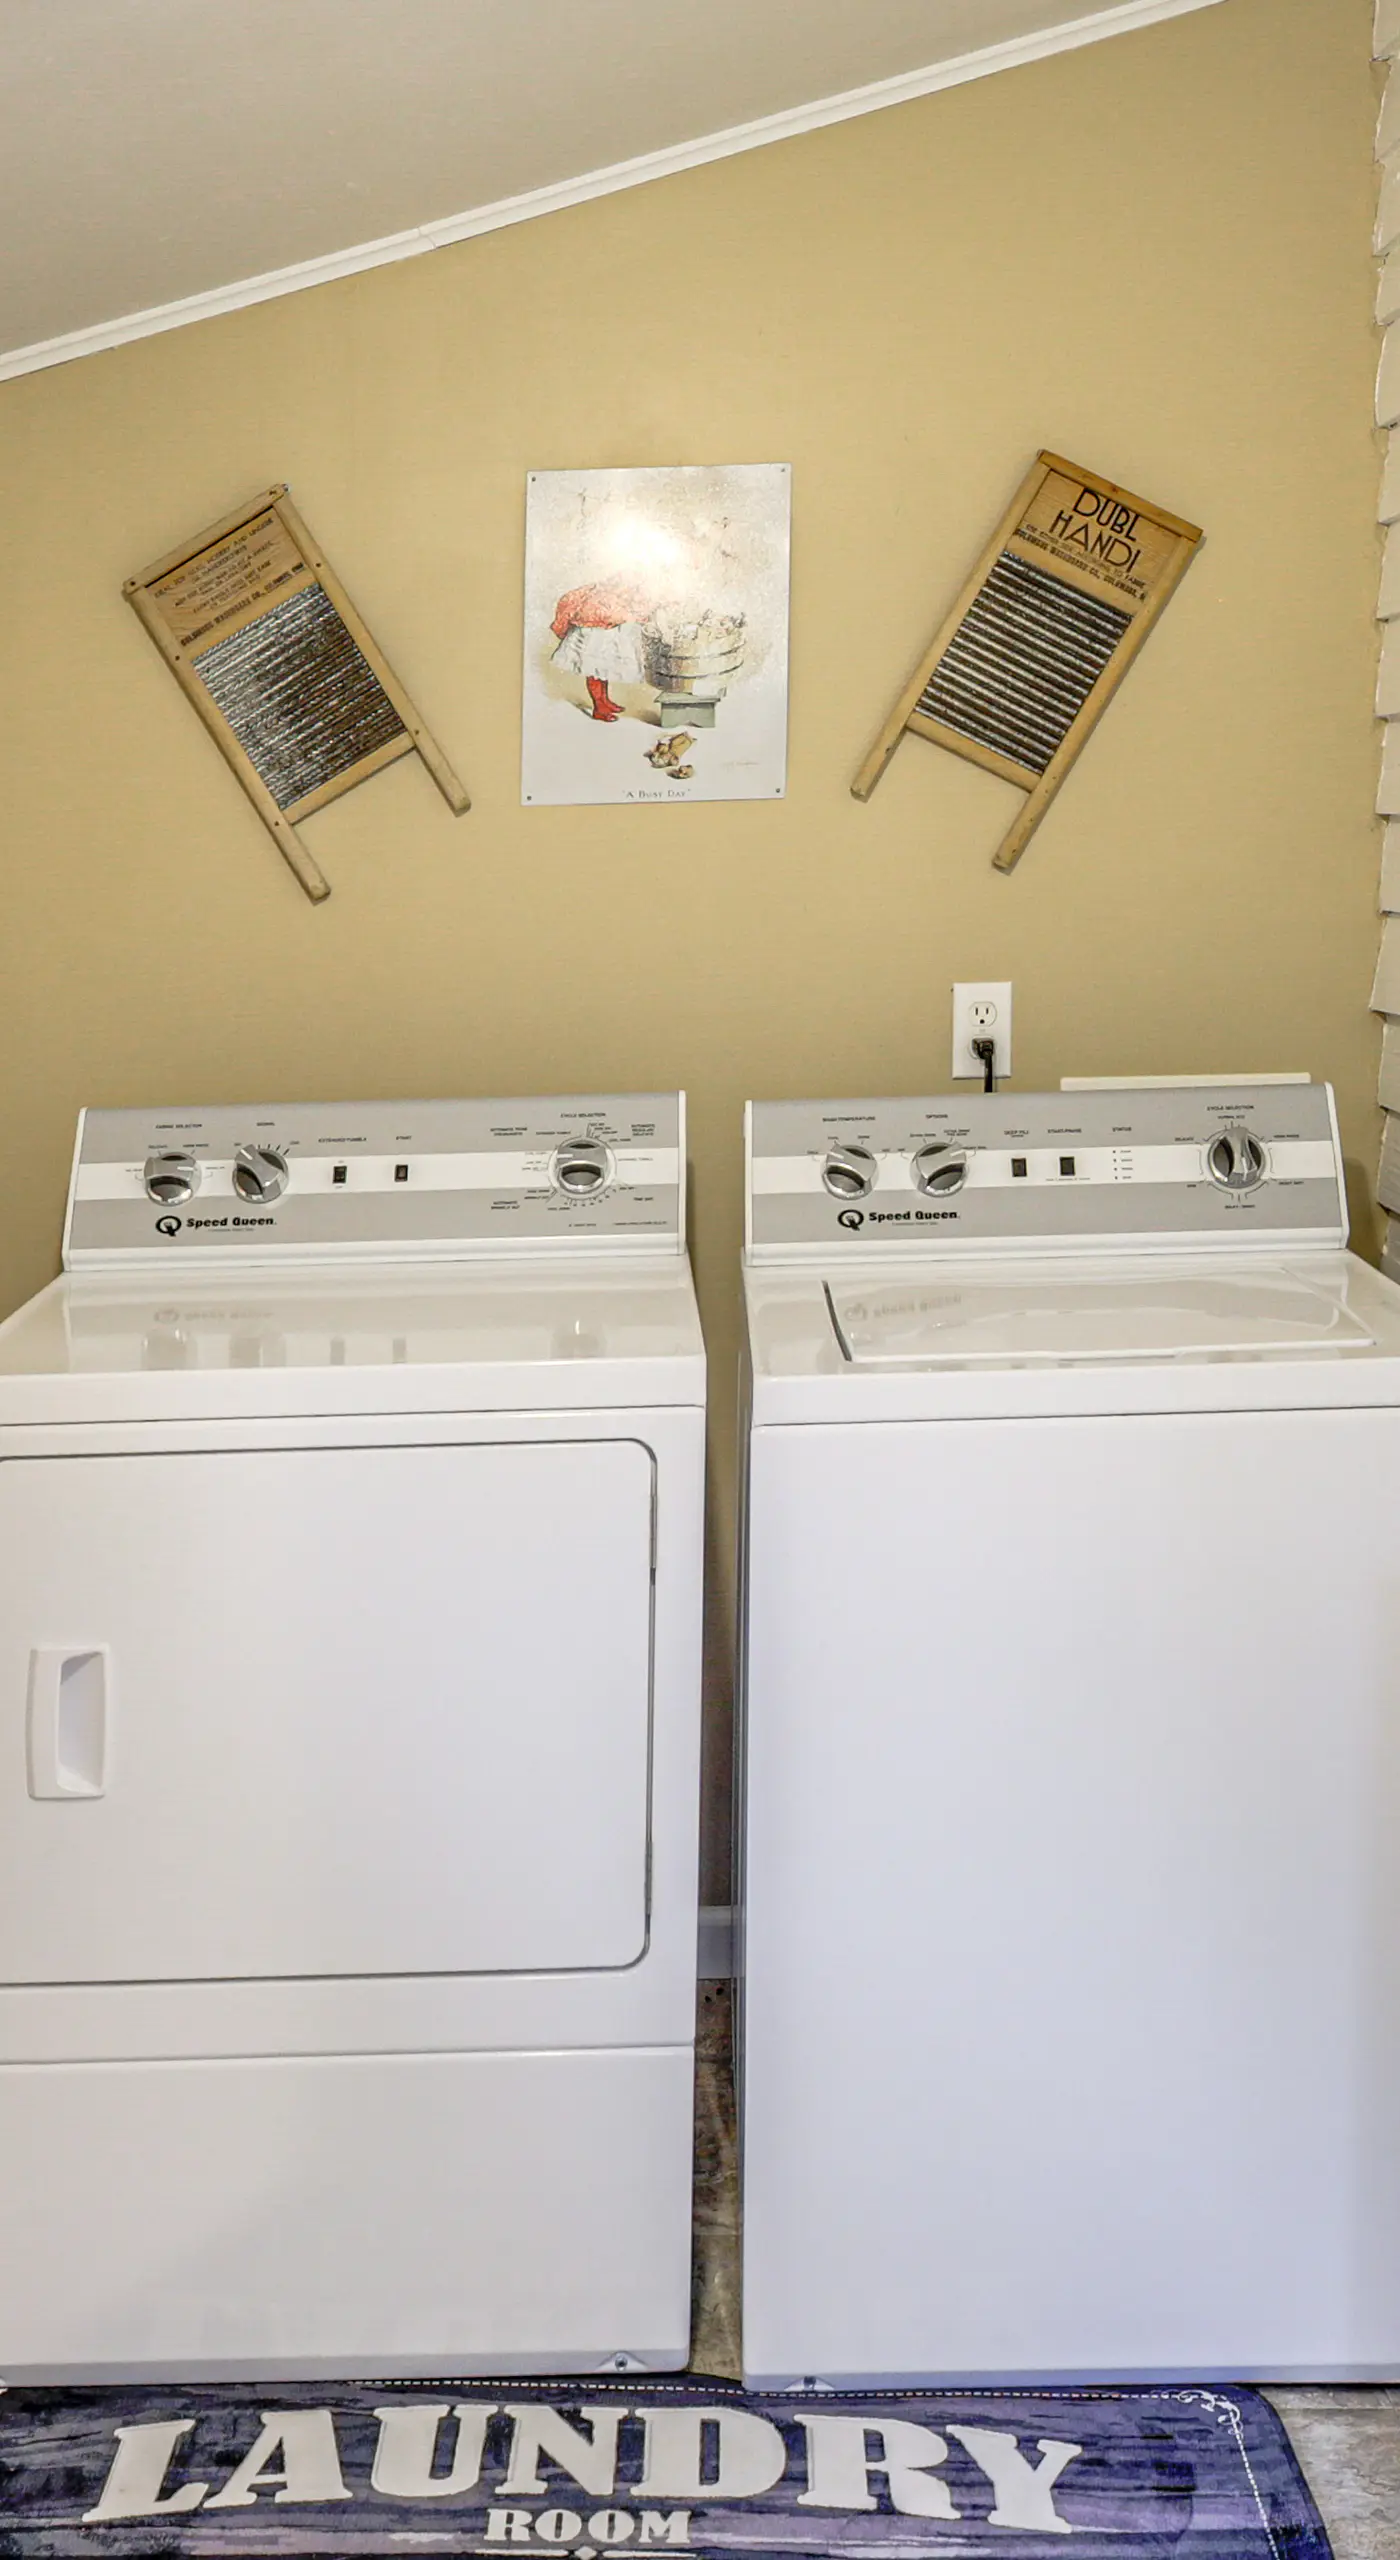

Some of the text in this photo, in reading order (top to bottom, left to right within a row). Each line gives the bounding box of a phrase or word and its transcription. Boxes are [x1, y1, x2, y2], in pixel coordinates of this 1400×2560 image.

[1072, 487, 1141, 541] DUBL
[1049, 510, 1141, 573] HANDI
[186, 1217, 229, 1229] Speed
[232, 1216, 275, 1226] Queen
[868, 1210, 911, 1223] Speed
[915, 1210, 958, 1220] Queen
[81, 2403, 1083, 2534] LAUNDRY
[483, 2508, 693, 2544] ROOM
